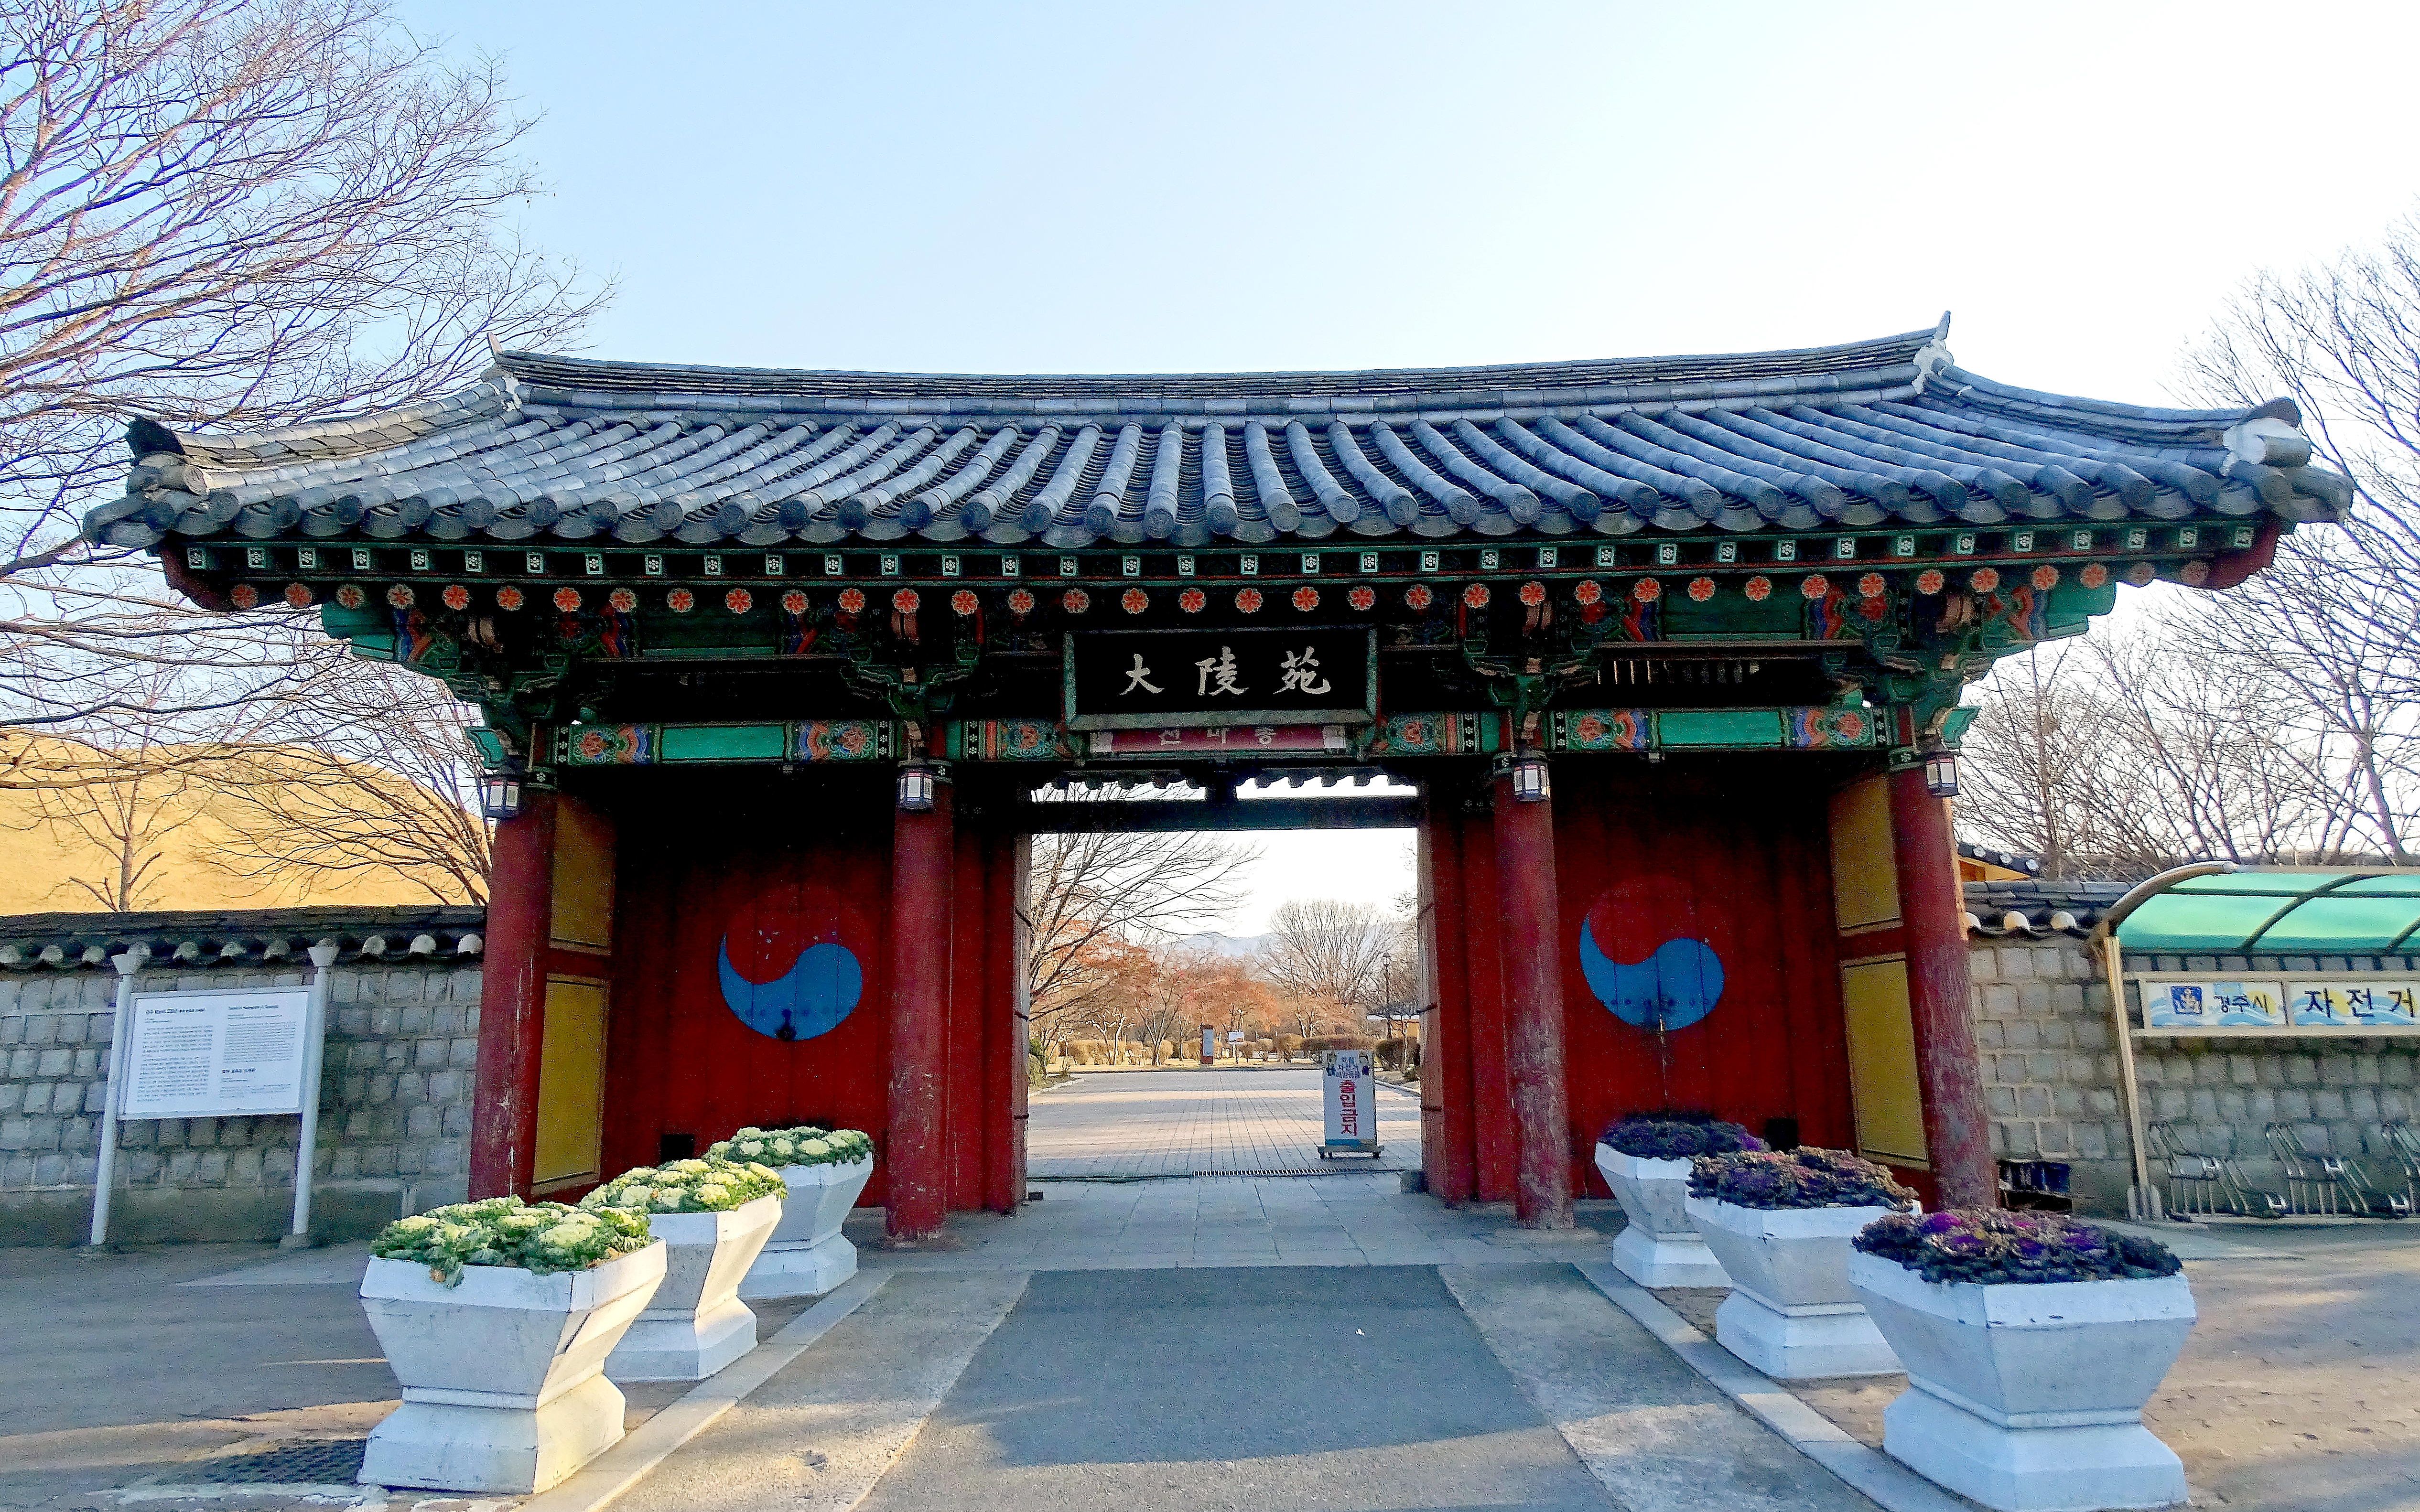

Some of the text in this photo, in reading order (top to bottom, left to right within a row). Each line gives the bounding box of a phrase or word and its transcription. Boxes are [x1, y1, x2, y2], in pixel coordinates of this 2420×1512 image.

[1120, 646, 1331, 696] 大陵苑
[2213, 993, 2269, 1015] 경주시
[2304, 987, 2415, 1018] 자전거
